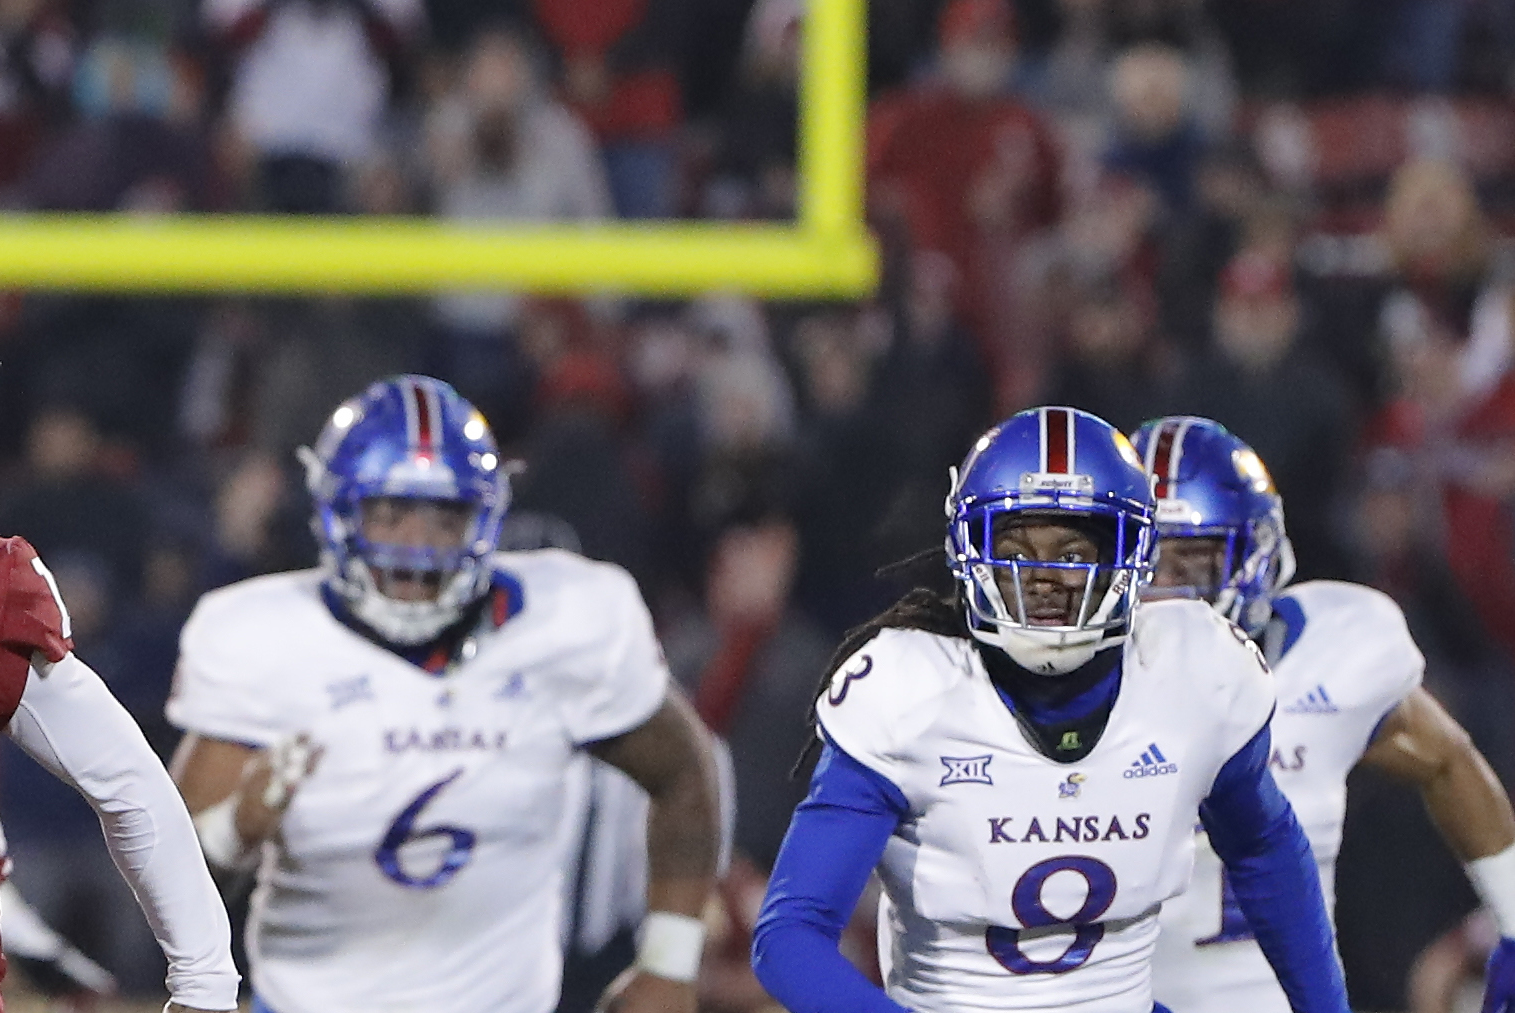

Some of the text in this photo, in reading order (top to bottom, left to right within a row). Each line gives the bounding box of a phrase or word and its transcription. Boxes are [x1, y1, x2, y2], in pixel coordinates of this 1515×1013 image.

[1122, 762, 1179, 780] adidas
[374, 766, 478, 889] 6
[987, 812, 1152, 844] KANSAS
[985, 854, 1118, 975] 8
